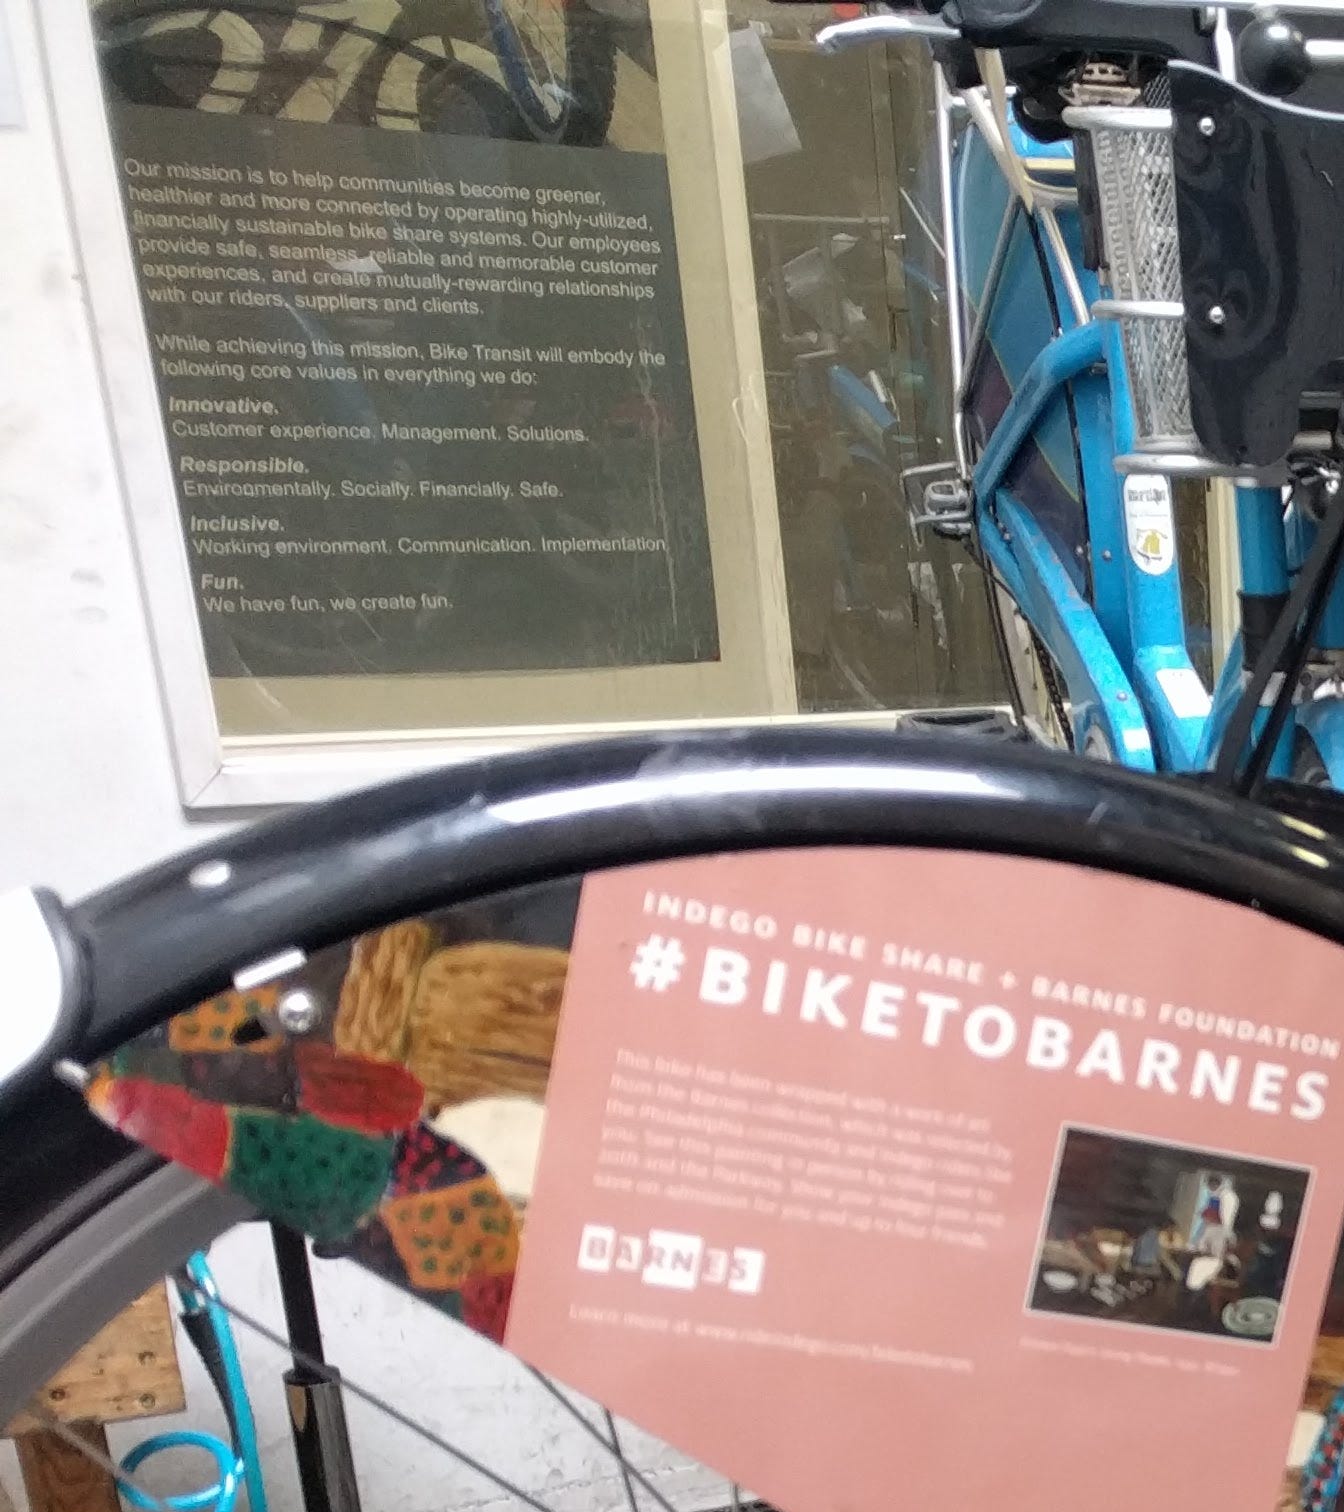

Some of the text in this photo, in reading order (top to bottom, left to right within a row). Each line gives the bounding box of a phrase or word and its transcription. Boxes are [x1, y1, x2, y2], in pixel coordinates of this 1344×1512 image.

[124, 158, 606, 205] Our mission is to help communities become greener,
[128, 185, 212, 205] healthier
[220, 192, 256, 208] and
[262, 194, 310, 211] more
[316, 198, 411, 217] connected
[417, 202, 439, 222] by
[444, 205, 528, 226] operating
[132, 209, 661, 254] financially sustainable bike share systems. Our employees
[138, 236, 210, 256] provide
[216, 240, 263, 260] safe,
[364, 247, 434, 267] reliable
[441, 251, 473, 268] and
[480, 254, 575, 272] memorable
[581, 258, 658, 276] customer
[142, 262, 655, 300] experiences, and create mutually-rewarding relationships
[148, 286, 484, 315] with our riders, suppliers and clients.
[155, 334, 665, 368] While achieving this mission, Bike Transit will embody the
[161, 359, 245, 381] following
[250, 364, 291, 379] core
[297, 364, 357, 380] values
[362, 364, 379, 380] in
[384, 367, 476, 388] everything
[480, 370, 506, 385] we
[172, 420, 263, 437] Customer
[381, 423, 501, 444] Management.
[507, 425, 589, 442] Solutions.
[179, 456, 310, 476] Responsible.
[183, 480, 564, 501] Environmentally. Socially. Financially. Safe.
[190, 515, 285, 532] Inclusive.
[193, 538, 270, 558] Working
[398, 537, 536, 554] Communication.
[201, 574, 244, 590] Fun.
[203, 593, 453, 613] We have fun, we create fun.
[643, 890, 778, 941] INDEGO
[792, 923, 867, 961] BIKE
[882, 942, 985, 986] SHARE
[1030, 975, 1147, 1021] BARNES
[1158, 1002, 1341, 1060] FOUNDATION
[629, 932, 1329, 1121] #BIKETOBARNES
[577, 1223, 767, 1296] BARNES
